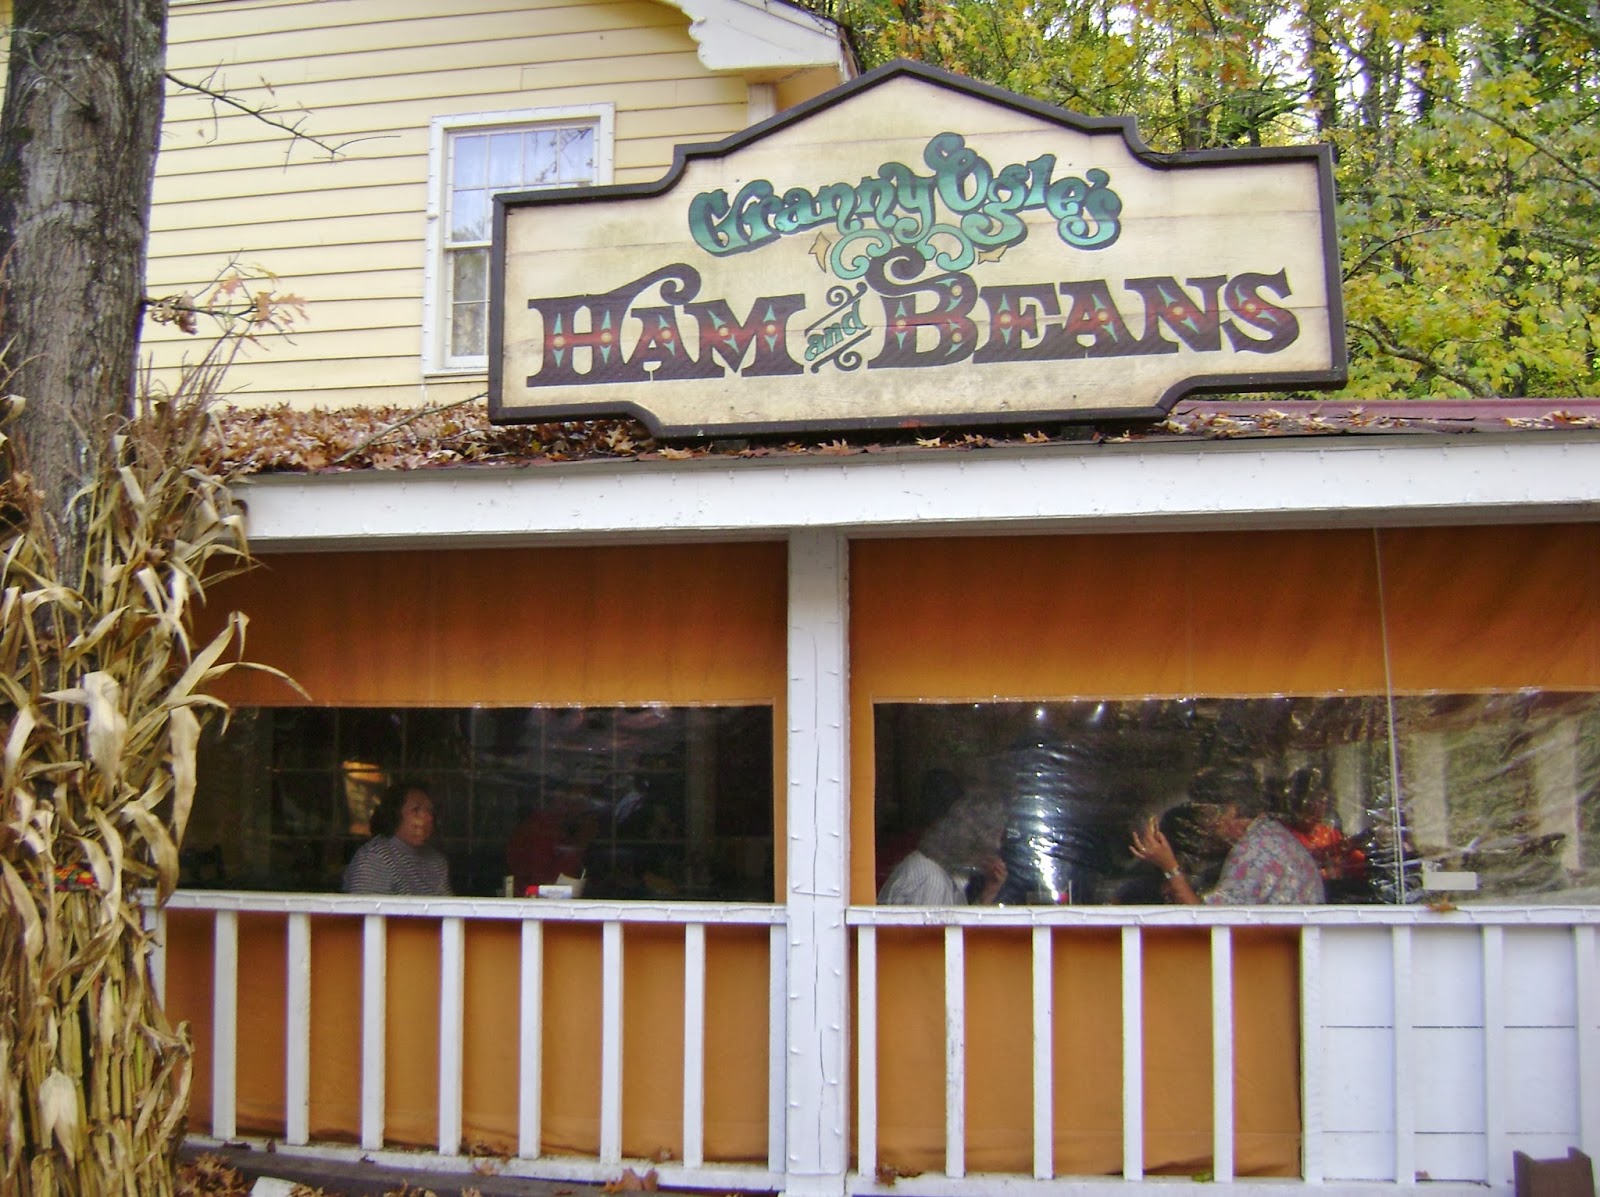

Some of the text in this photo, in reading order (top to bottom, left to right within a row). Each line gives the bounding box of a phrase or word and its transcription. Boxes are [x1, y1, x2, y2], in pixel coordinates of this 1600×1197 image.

[689, 161, 939, 257] Granny
[526, 246, 1300, 388] HAM and BEANS
